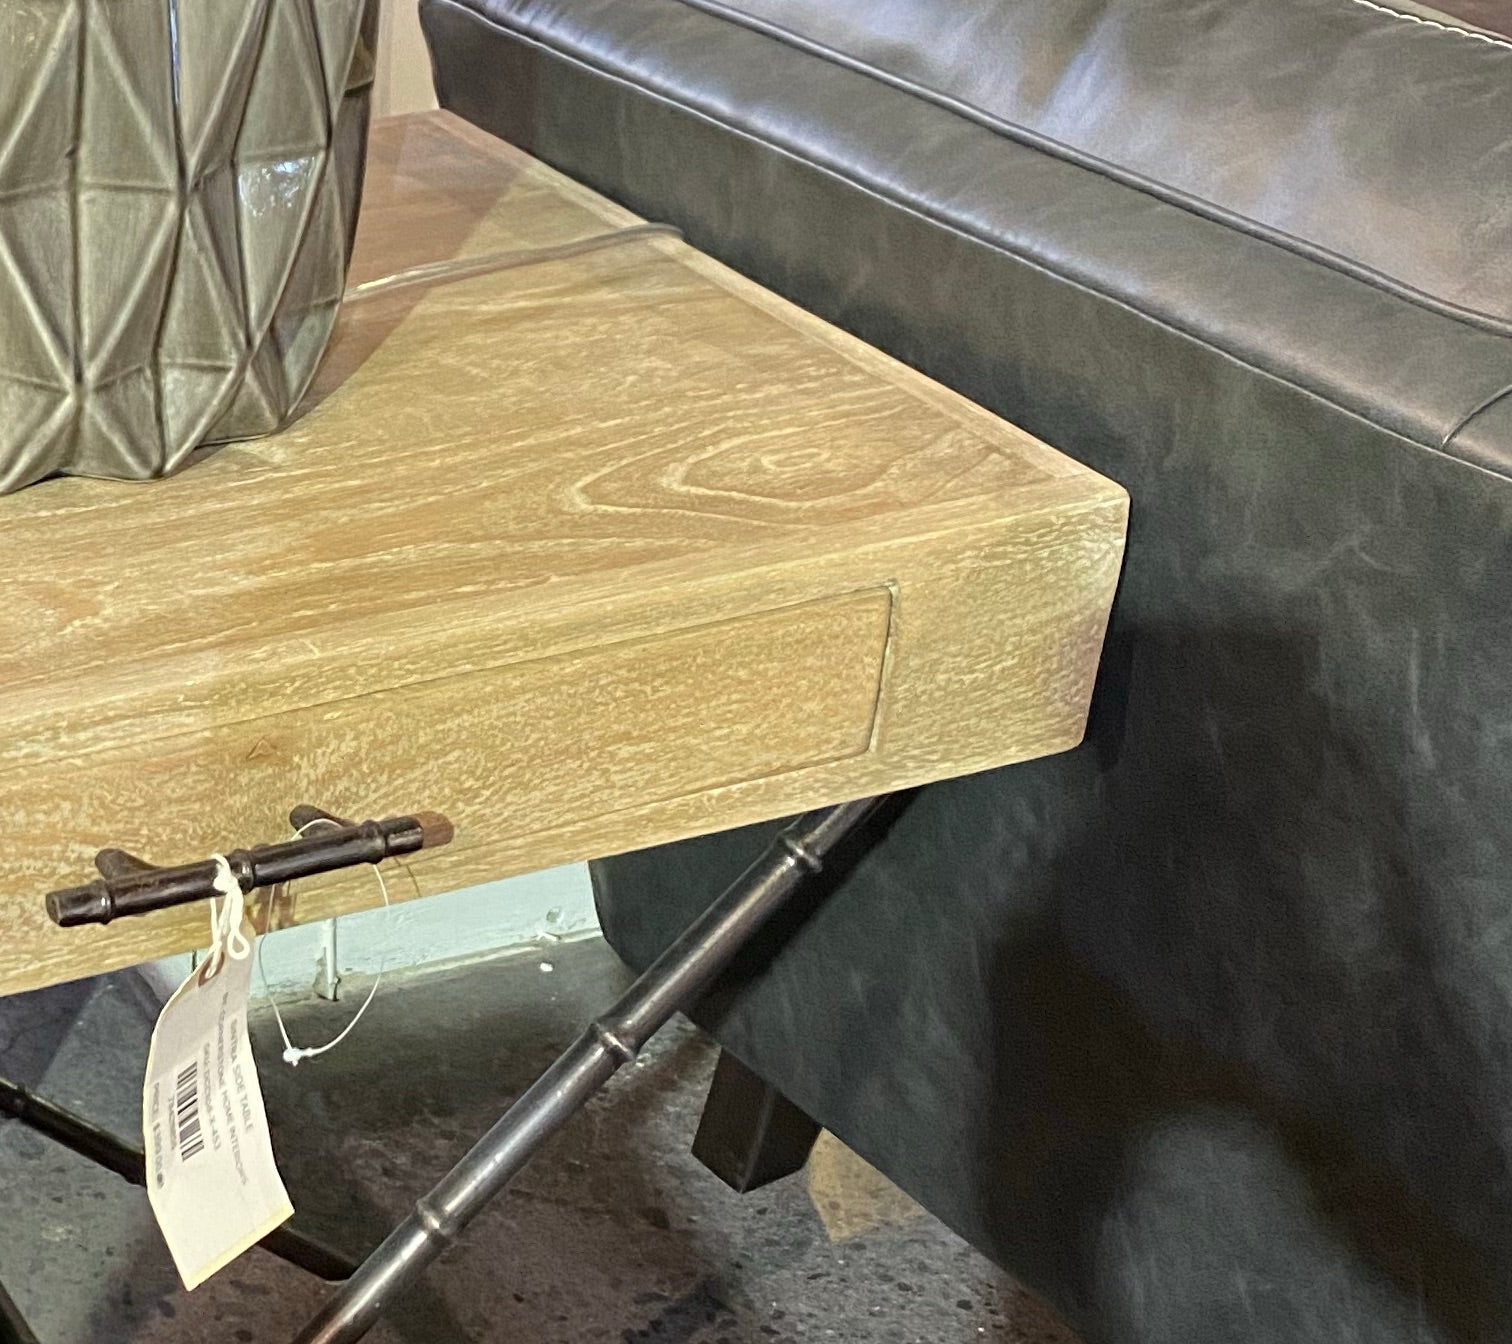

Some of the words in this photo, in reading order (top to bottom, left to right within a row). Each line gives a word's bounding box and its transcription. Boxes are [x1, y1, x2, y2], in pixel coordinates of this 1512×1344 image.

[222, 1089, 236, 1124] HOME
[232, 1063, 244, 1095] SIDE
[240, 1093, 254, 1131] TABLE
